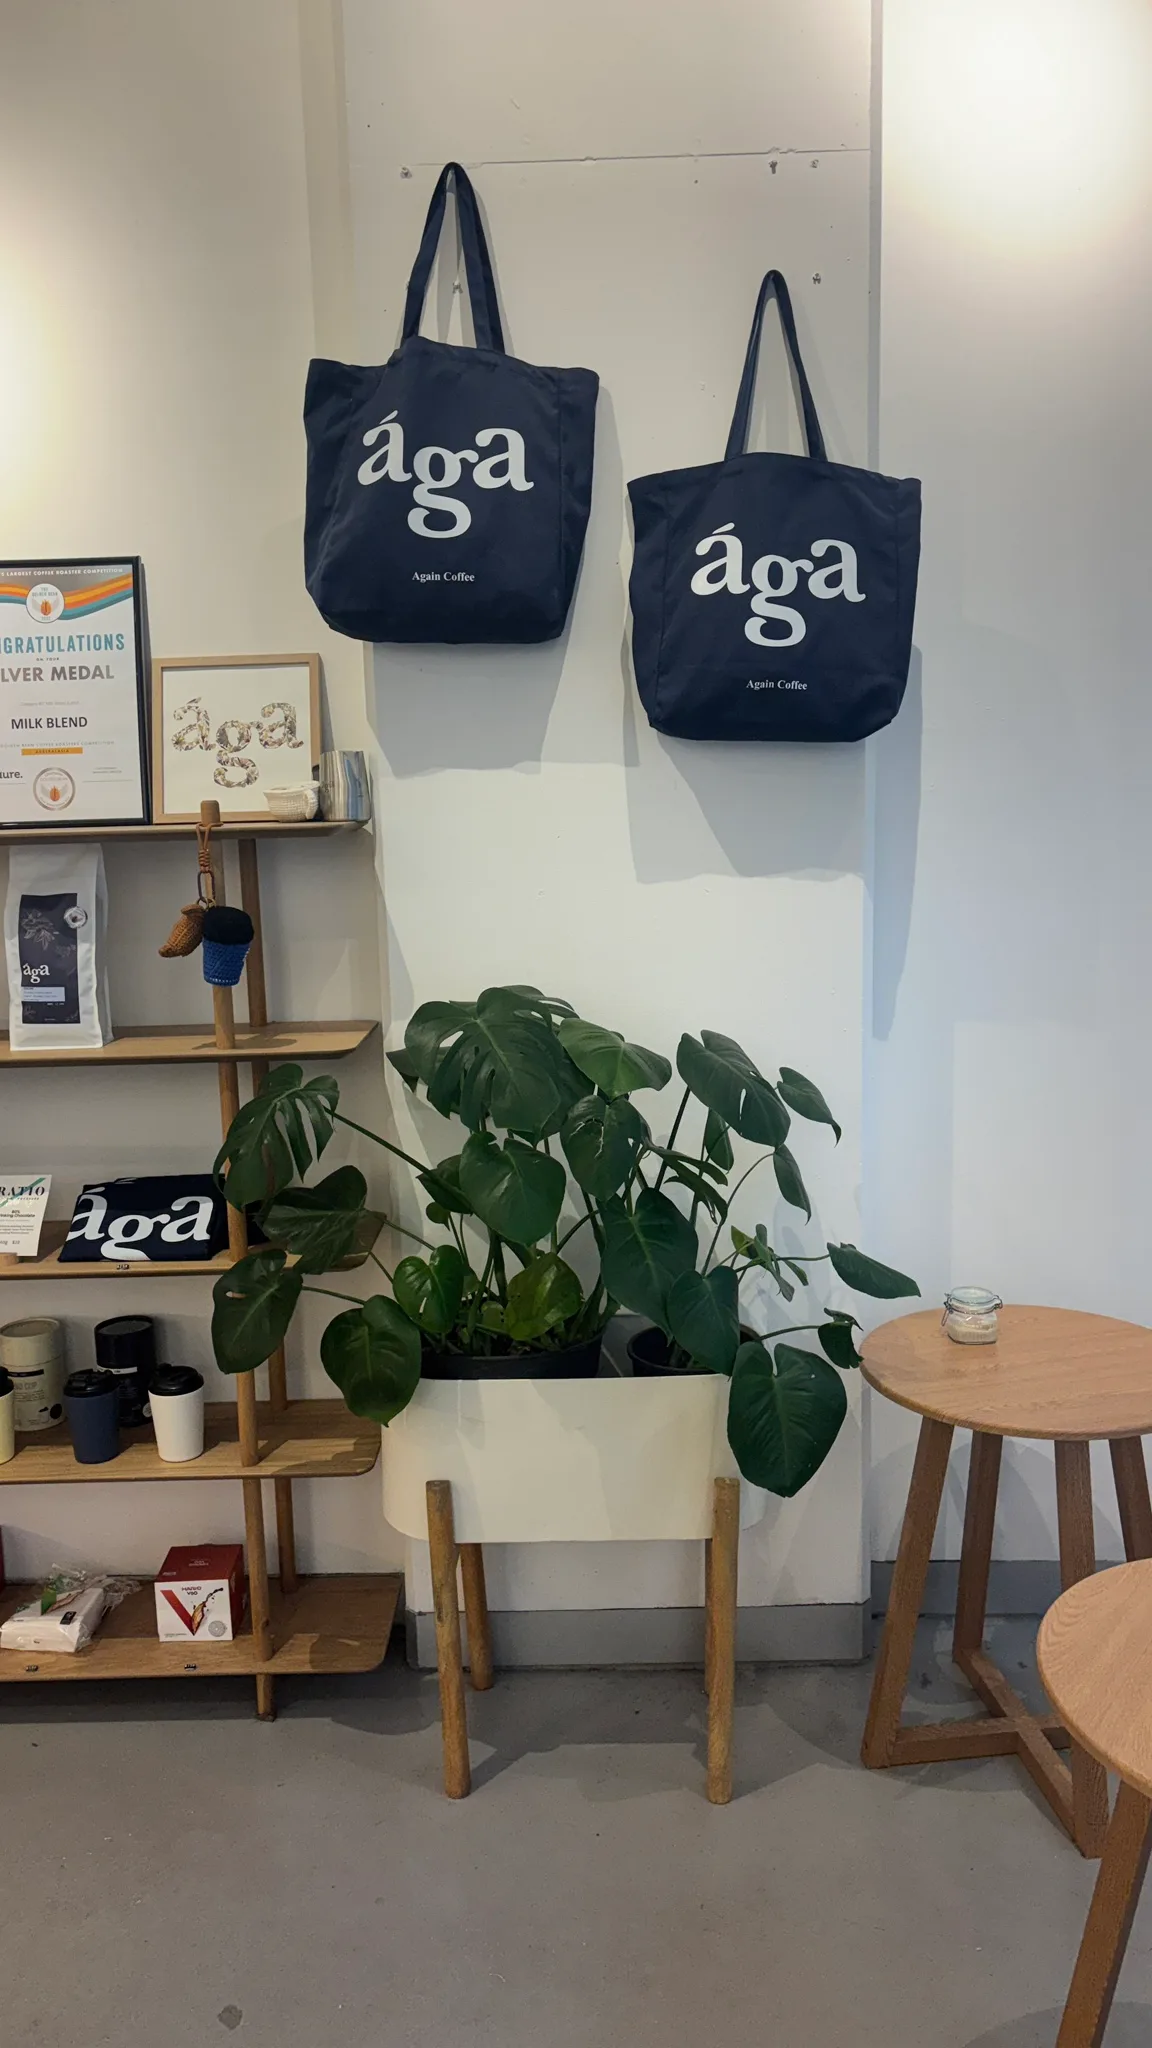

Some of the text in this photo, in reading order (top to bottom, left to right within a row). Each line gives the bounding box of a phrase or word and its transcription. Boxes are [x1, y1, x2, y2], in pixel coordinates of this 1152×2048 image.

[357, 410, 534, 539] ága
[412, 571, 475, 583] Again Coffee
[691, 522, 867, 647] ága
[0, 633, 125, 654] GRATULATIONS
[1, 665, 115, 683] LVER MEDAL
[746, 679, 808, 690] Again Coffee
[11, 716, 88, 730] MILK BLEND
[171, 697, 304, 788] ága
[23, 963, 50, 984] ága
[66, 1187, 214, 1261] ága
